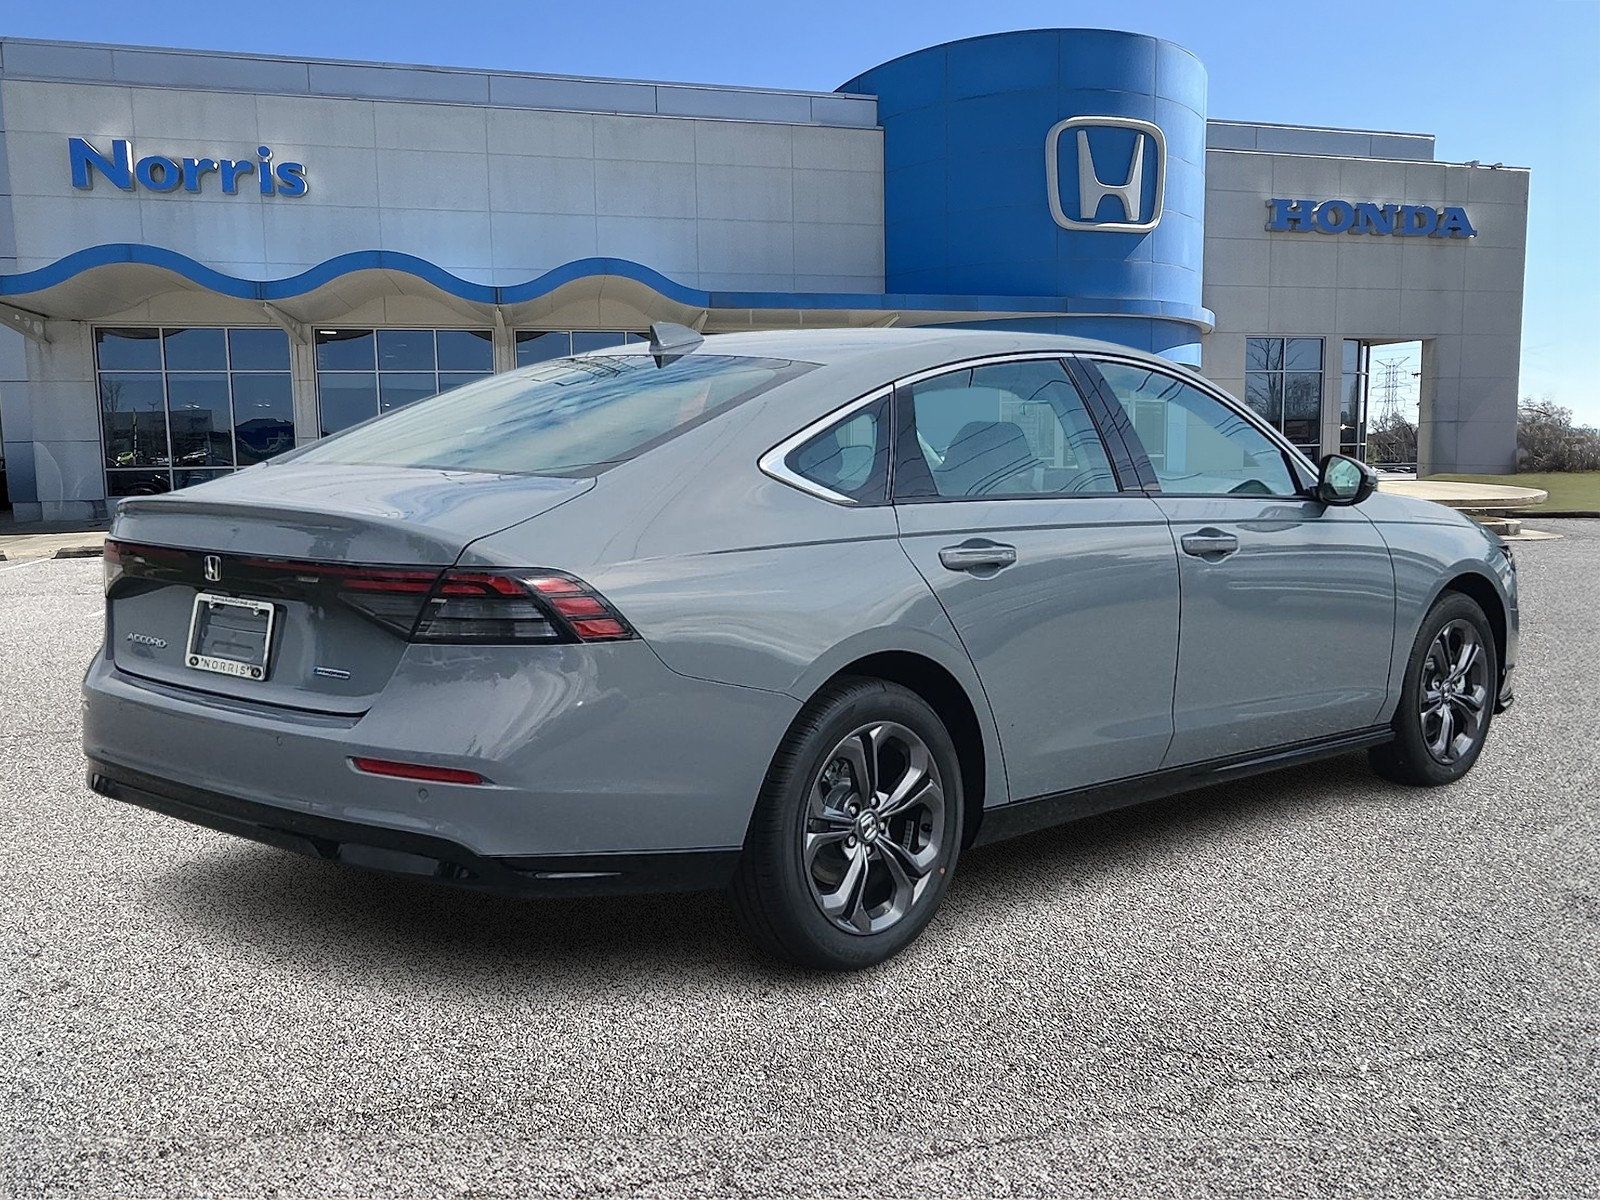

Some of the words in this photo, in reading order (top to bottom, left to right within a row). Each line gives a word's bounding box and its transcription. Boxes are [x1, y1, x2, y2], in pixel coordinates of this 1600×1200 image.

[68, 137, 308, 197] Norris
[1265, 198, 1477, 239] HONDA
[127, 632, 167, 648] ACCORD
